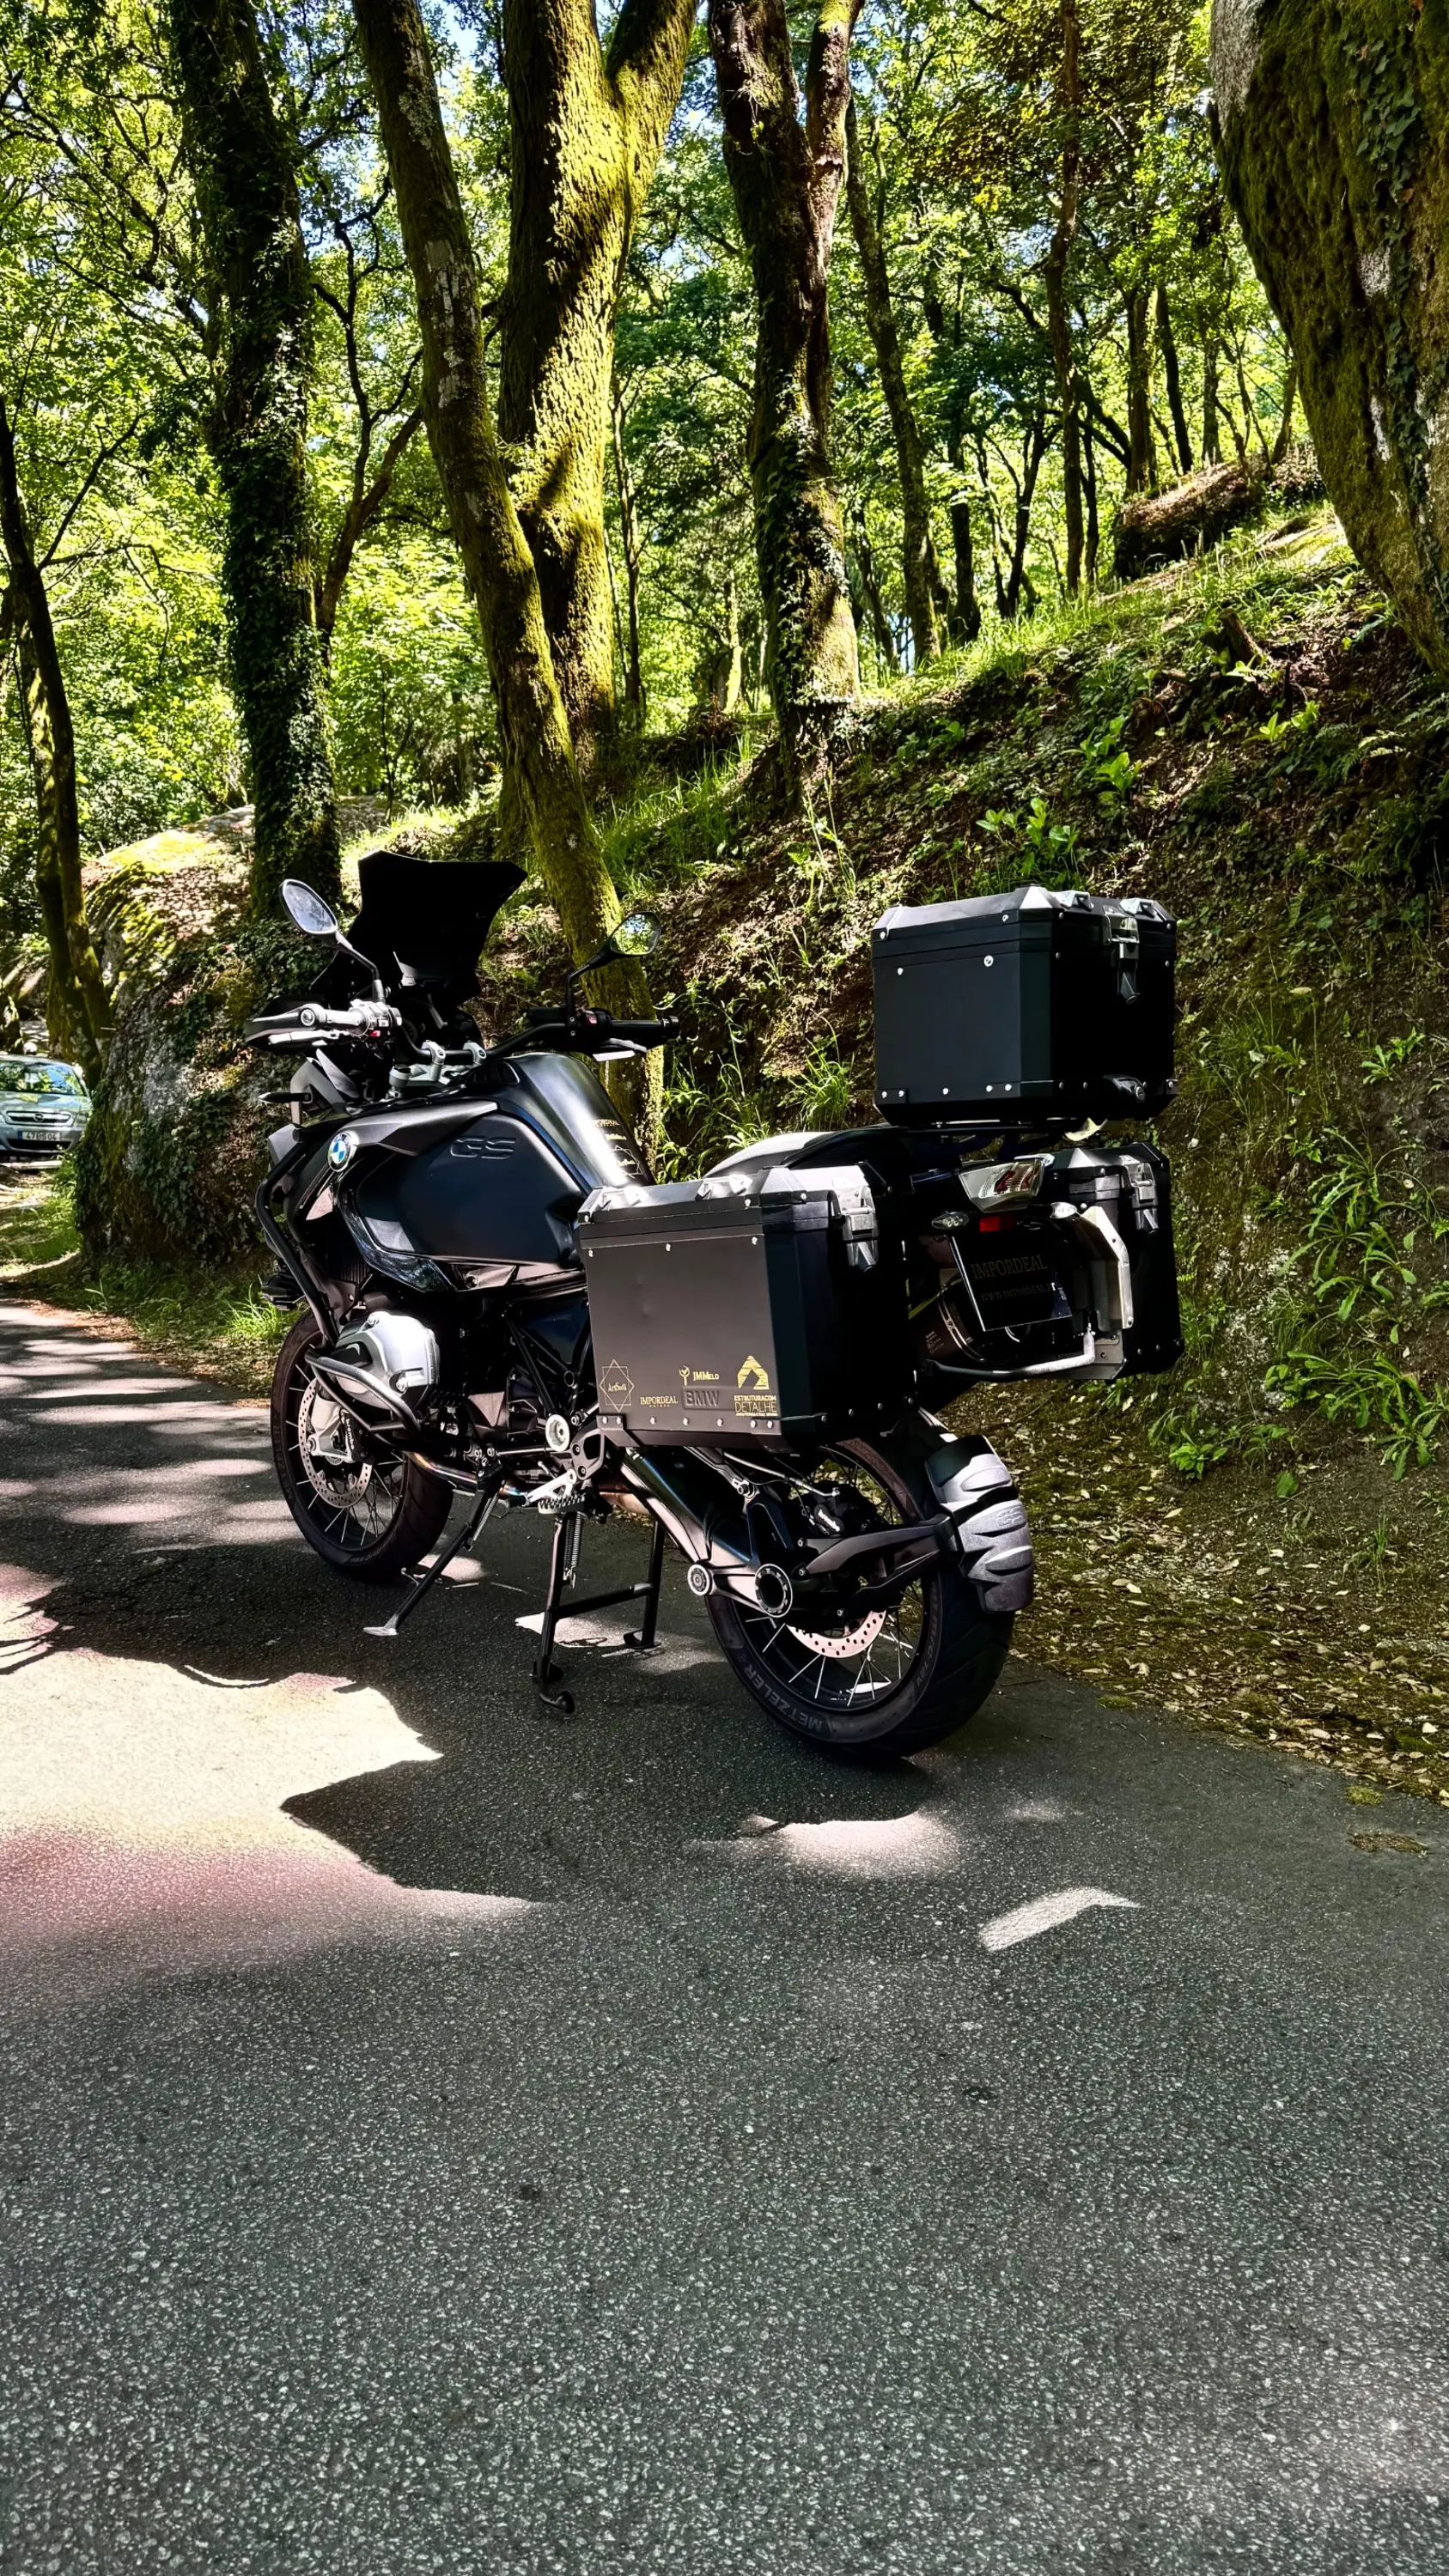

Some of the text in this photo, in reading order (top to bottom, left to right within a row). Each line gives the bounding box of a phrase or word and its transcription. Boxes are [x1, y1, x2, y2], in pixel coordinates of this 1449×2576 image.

[450, 1138, 515, 1159] GS
[970, 1255, 1048, 1280] IMPORDEAL
[640, 1395, 679, 1405] IMPORDEAL
[685, 1390, 720, 1406] BMW
[735, 1401, 777, 1413] DETALHE
[743, 1663, 823, 1732] METZELER
